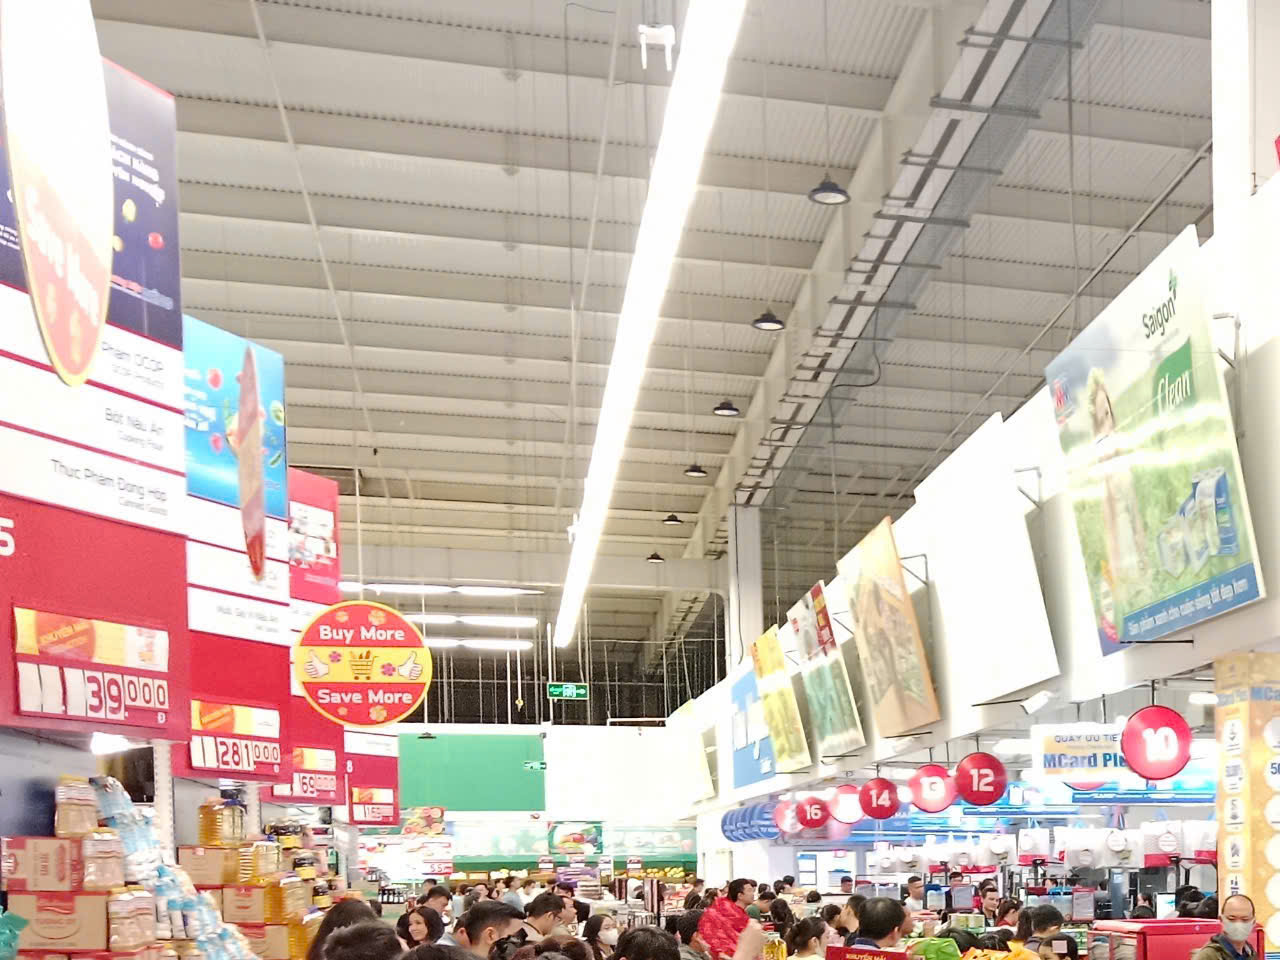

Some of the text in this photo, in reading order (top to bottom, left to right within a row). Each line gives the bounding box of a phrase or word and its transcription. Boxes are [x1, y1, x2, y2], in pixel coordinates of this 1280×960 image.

[1142, 297, 1177, 339] Saigon
[1157, 370, 1191, 415] Clean
[319, 625, 405, 644] Buy More
[317, 689, 413, 705] Save More
[1142, 726, 1179, 762] 10
[1043, 753, 1098, 769] MCard
[969, 768, 994, 792] 12
[869, 789, 891, 808] 14
[805, 805, 822, 820] 16
